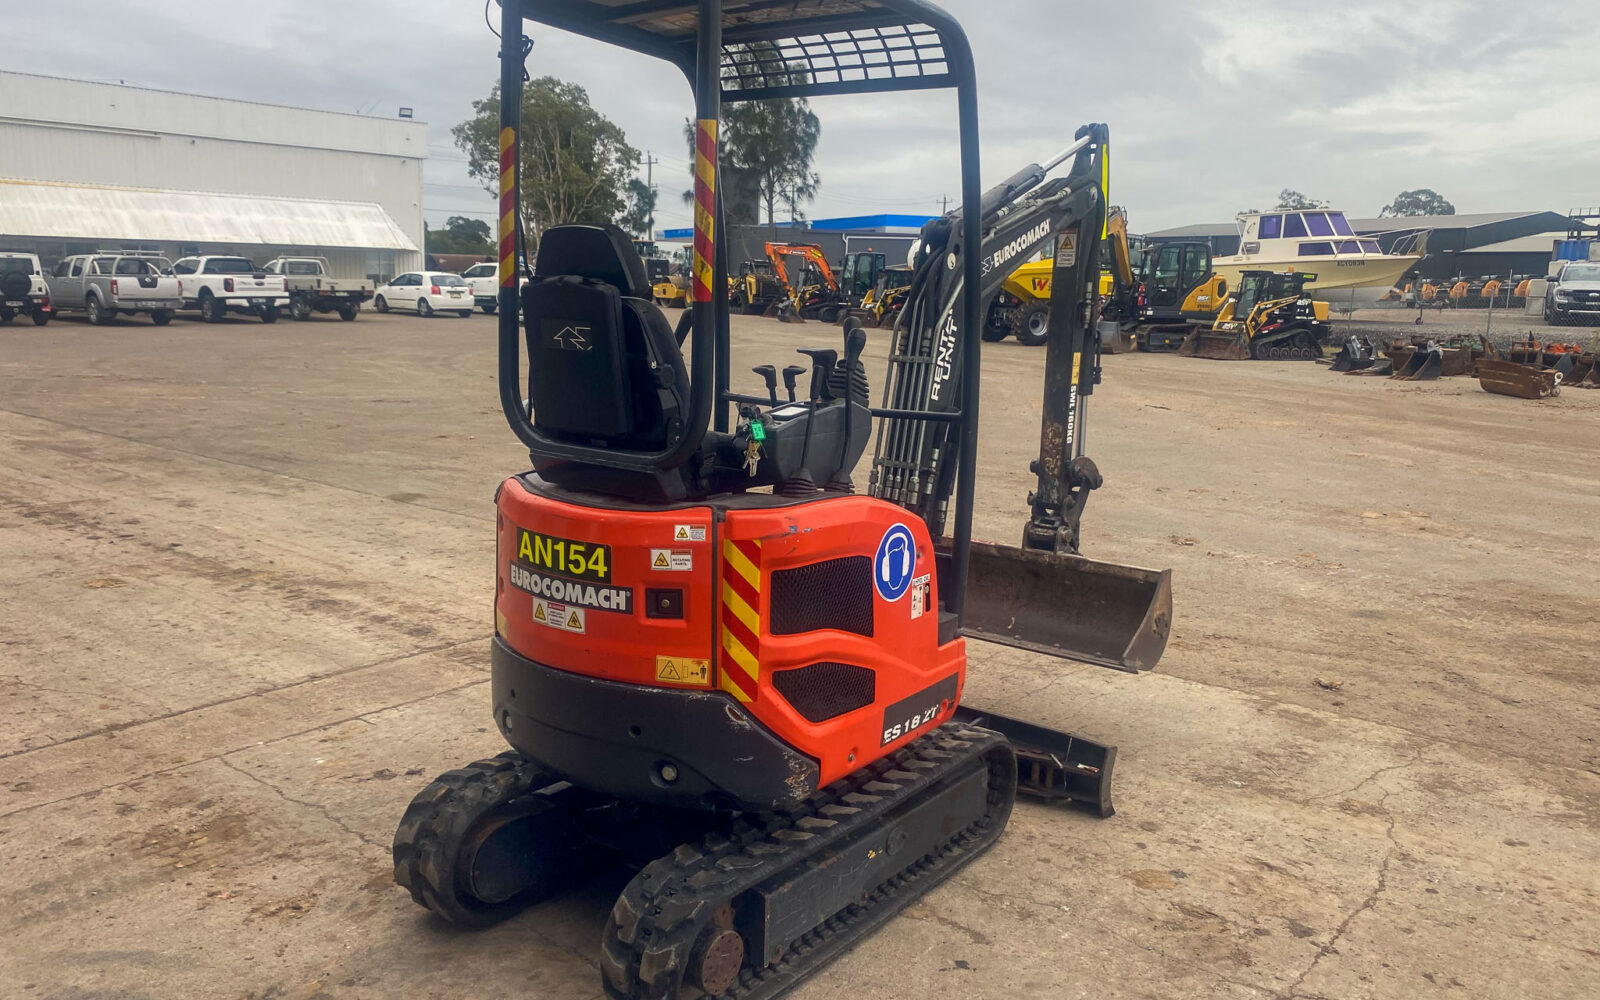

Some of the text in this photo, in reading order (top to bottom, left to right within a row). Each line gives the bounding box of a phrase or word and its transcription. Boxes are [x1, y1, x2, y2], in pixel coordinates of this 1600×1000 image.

[993, 219, 1051, 268] EUROCOMACH
[942, 318, 958, 380] UNIT
[1066, 385, 1077, 444] SWL 160KG
[519, 530, 608, 578] AN154
[510, 563, 627, 611] EUROCOMACH
[883, 724, 902, 744] ES
[904, 714, 921, 733] 18
